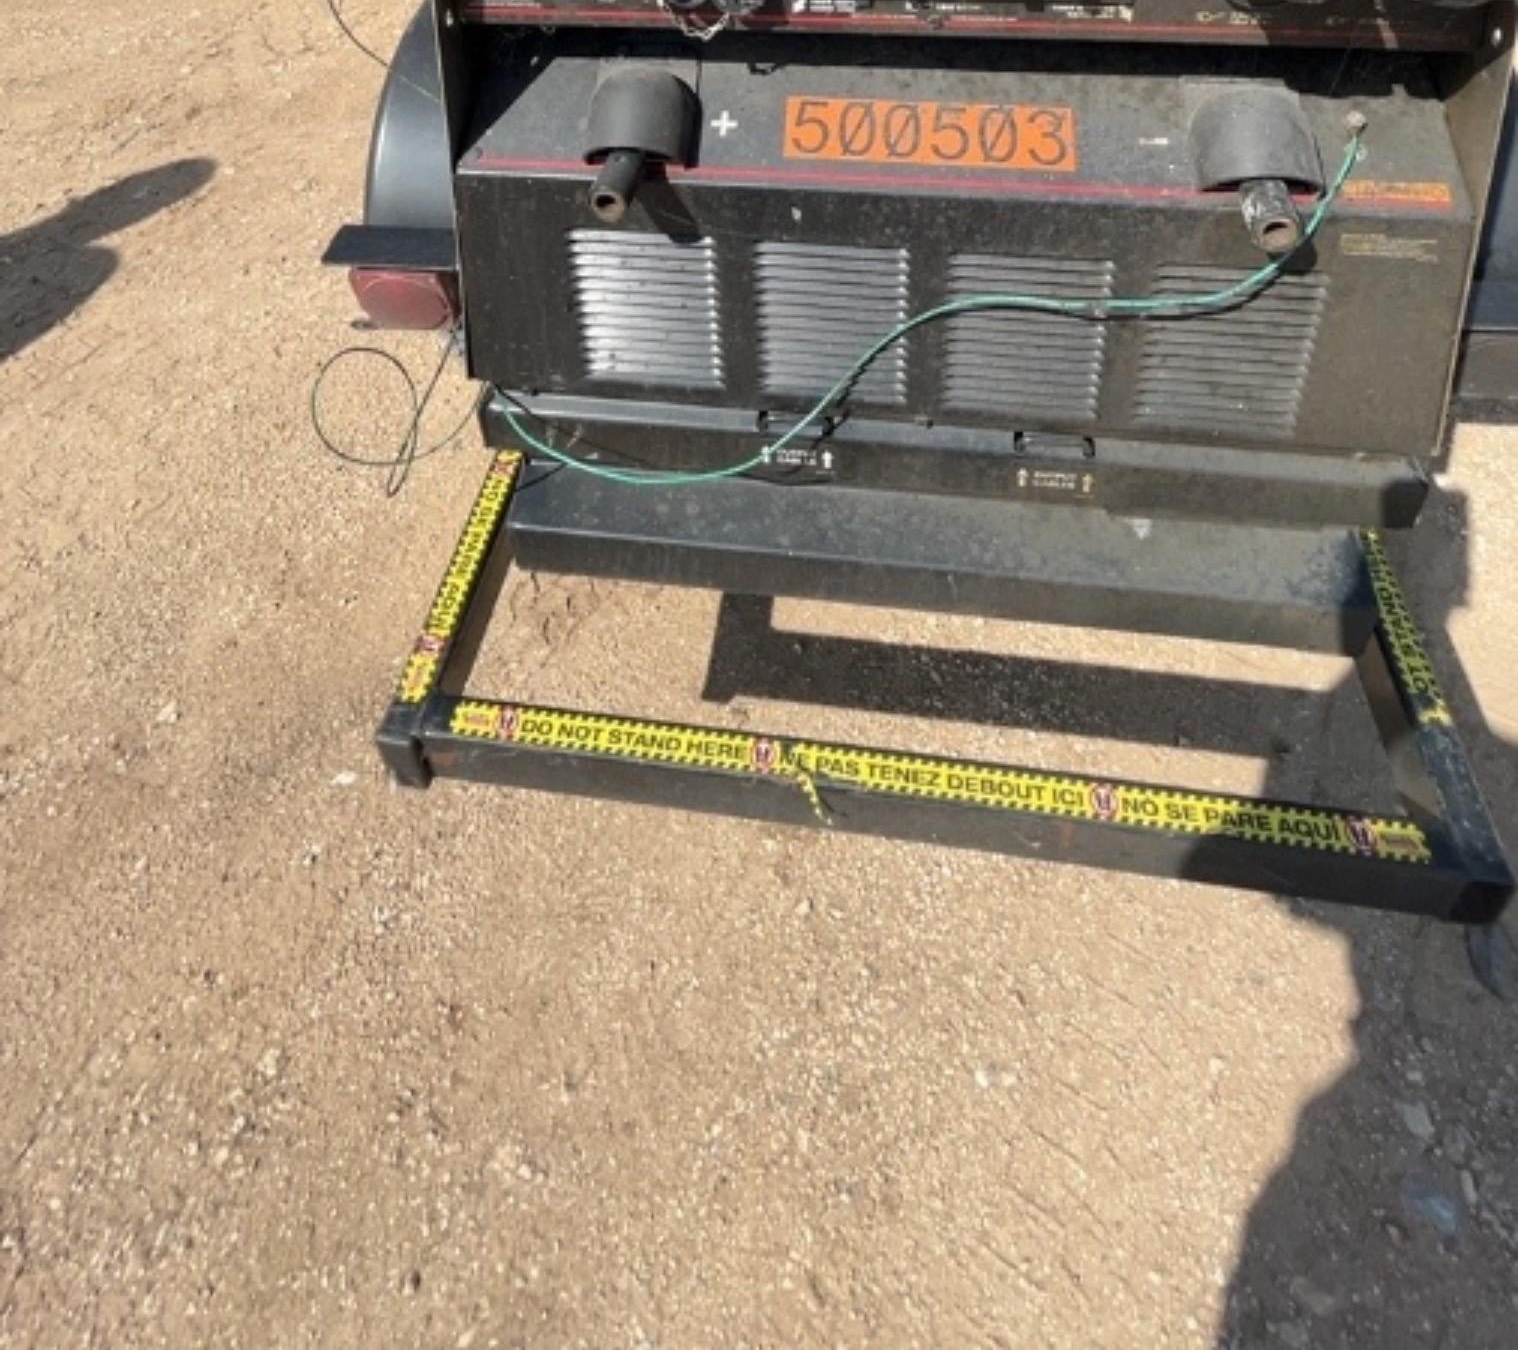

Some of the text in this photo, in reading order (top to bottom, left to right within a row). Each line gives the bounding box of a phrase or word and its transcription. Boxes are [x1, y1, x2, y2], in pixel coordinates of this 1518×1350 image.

[790, 100, 1067, 167] 500503
[521, 718, 747, 760] DO NOT STAND HERE
[816, 756, 859, 777] PAS
[866, 764, 941, 788] TENEZ
[947, 773, 1046, 800] DEBOUT
[1053, 789, 1083, 807] ICI
[1122, 797, 1158, 817] NO
[1166, 804, 1197, 823] SE
[1205, 808, 1272, 833] PARE
